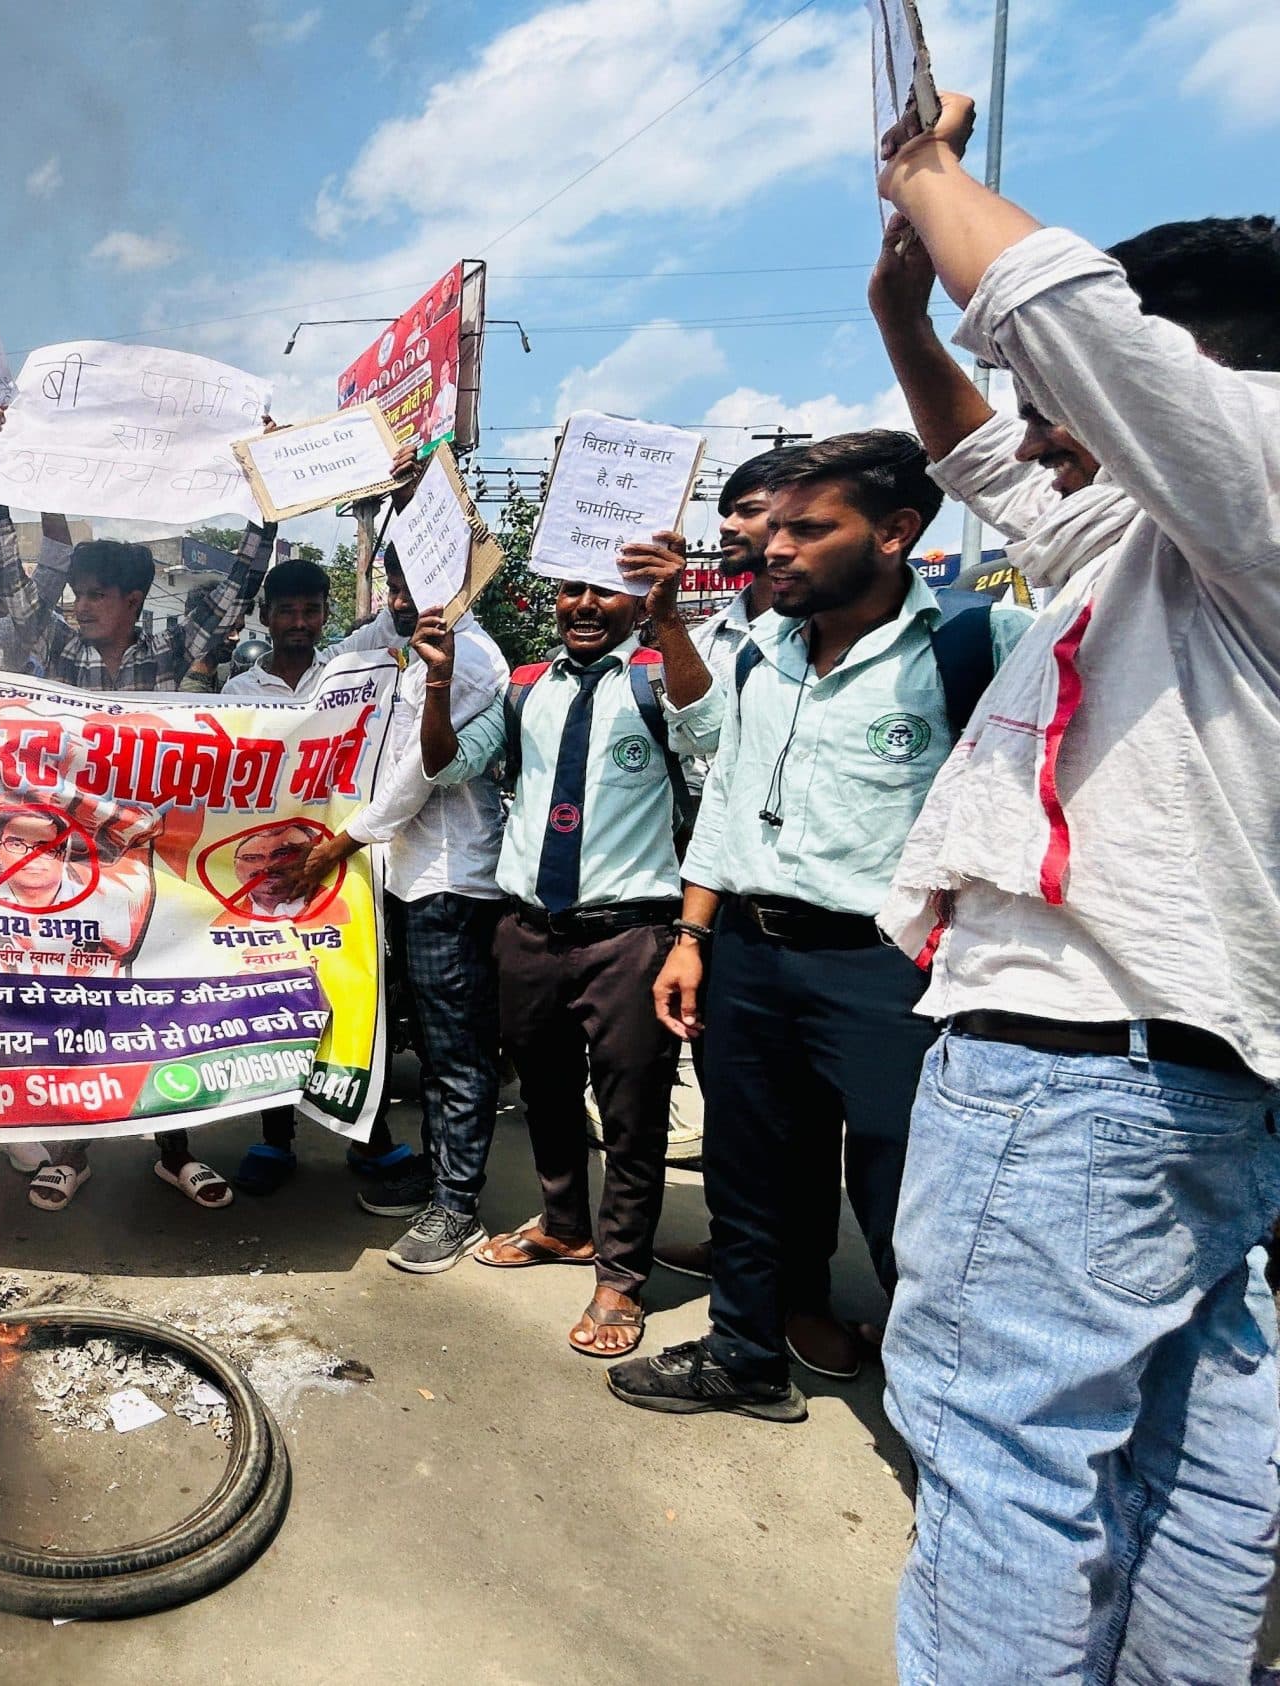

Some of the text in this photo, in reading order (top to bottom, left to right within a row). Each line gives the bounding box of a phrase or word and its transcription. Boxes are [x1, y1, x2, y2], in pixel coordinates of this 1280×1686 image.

[401, 387, 420, 416] मोदी
[421, 378, 433, 402] जी
[111, 424, 178, 456] साथ
[273, 428, 354, 461] #Justice for
[582, 432, 675, 465] बिहार में बहार
[292, 455, 357, 480] B Pharm
[616, 473, 638, 490] बी-
[576, 500, 645, 524] फार्मासिस्ट
[570, 526, 611, 551] बेहाल
[918, 564, 946, 578] SBI
[75, 713, 287, 810] आक्रोश
[38, 918, 101, 947] अमृत
[210, 926, 287, 948] मंगल
[19, 981, 48, 1004] से
[49, 983, 113, 1007] रमेश
[114, 983, 176, 1007] चौक
[180, 976, 313, 1006] औरंगाबाद
[54, 1027, 108, 1055] 12:00
[109, 1023, 157, 1053] बजे
[160, 1021, 187, 1051] से
[188, 1017, 248, 1045] 02:00
[249, 1006, 300, 1034] बजे
[26, 1072, 124, 1111] Singh
